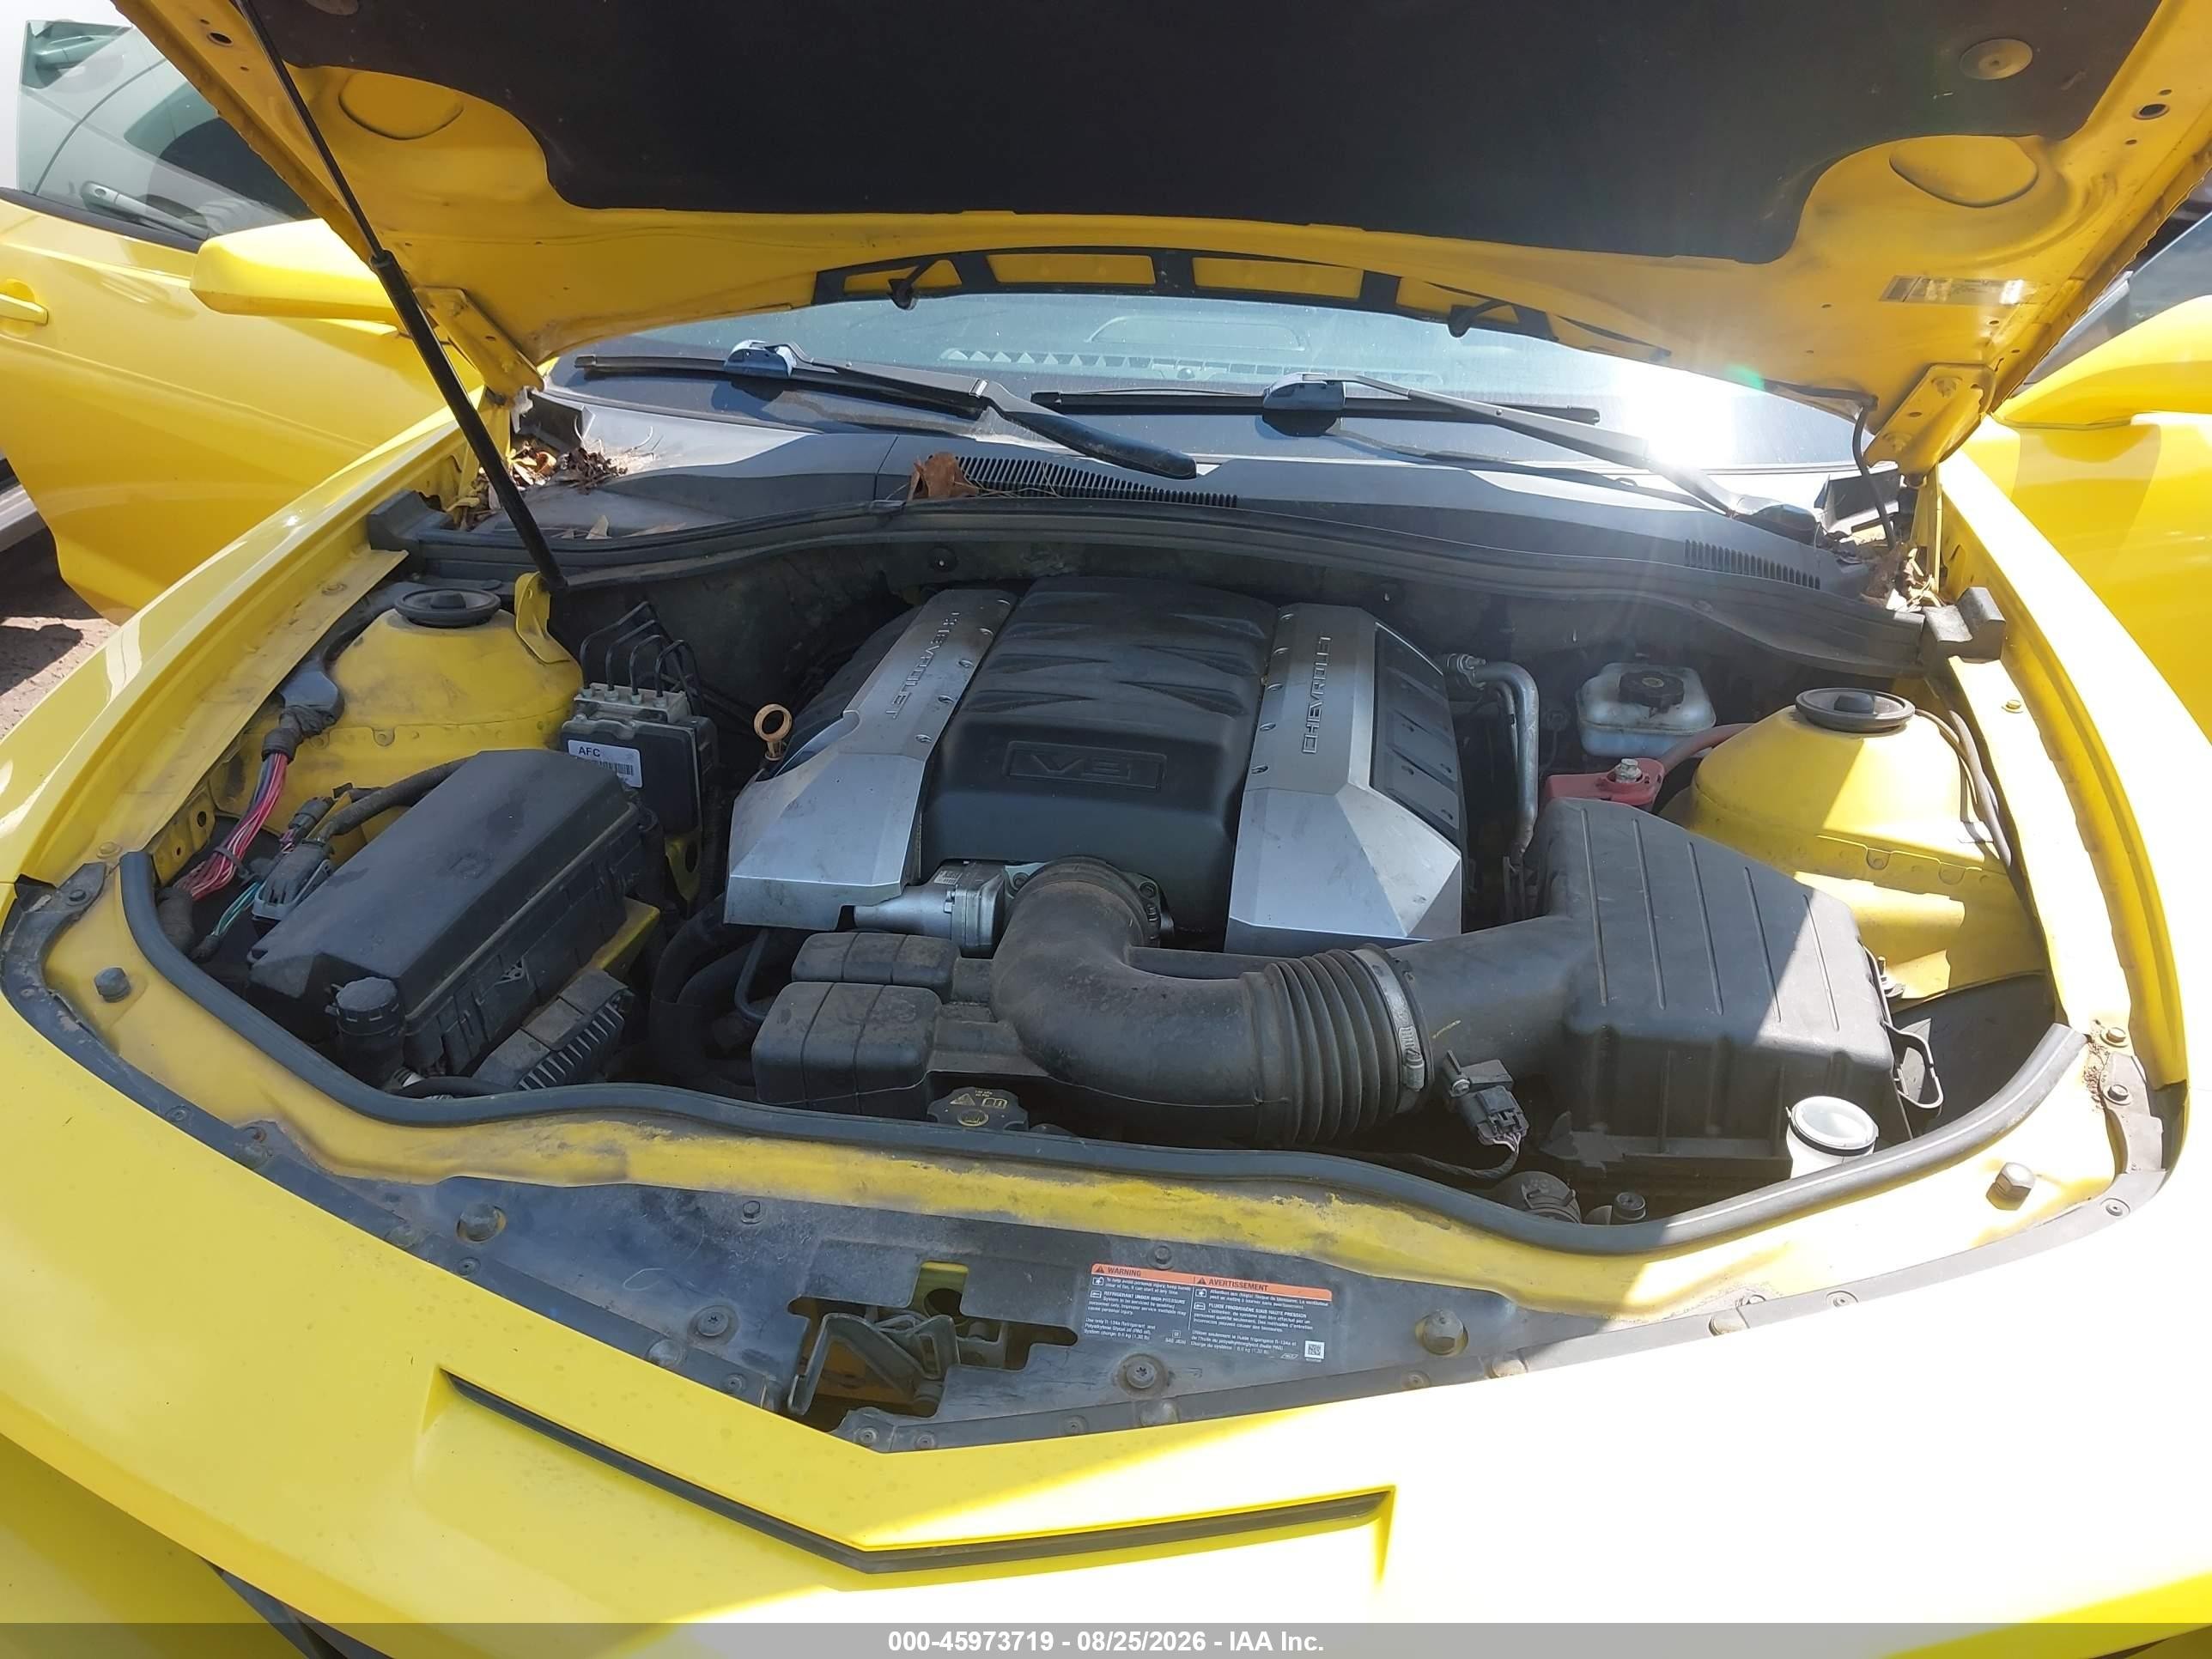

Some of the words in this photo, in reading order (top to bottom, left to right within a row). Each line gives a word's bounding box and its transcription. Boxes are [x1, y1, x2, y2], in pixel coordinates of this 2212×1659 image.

[1302, 636, 1332, 754] CHEVROLET
[578, 746, 601, 757] AFC
[1107, 1267, 1142, 1278] WARNING
[1208, 1278, 1269, 1292] AVERTISSEMENT
[1162, 1296, 1186, 1304] PRESSURE
[1284, 1310, 1307, 1319] PRESSION
